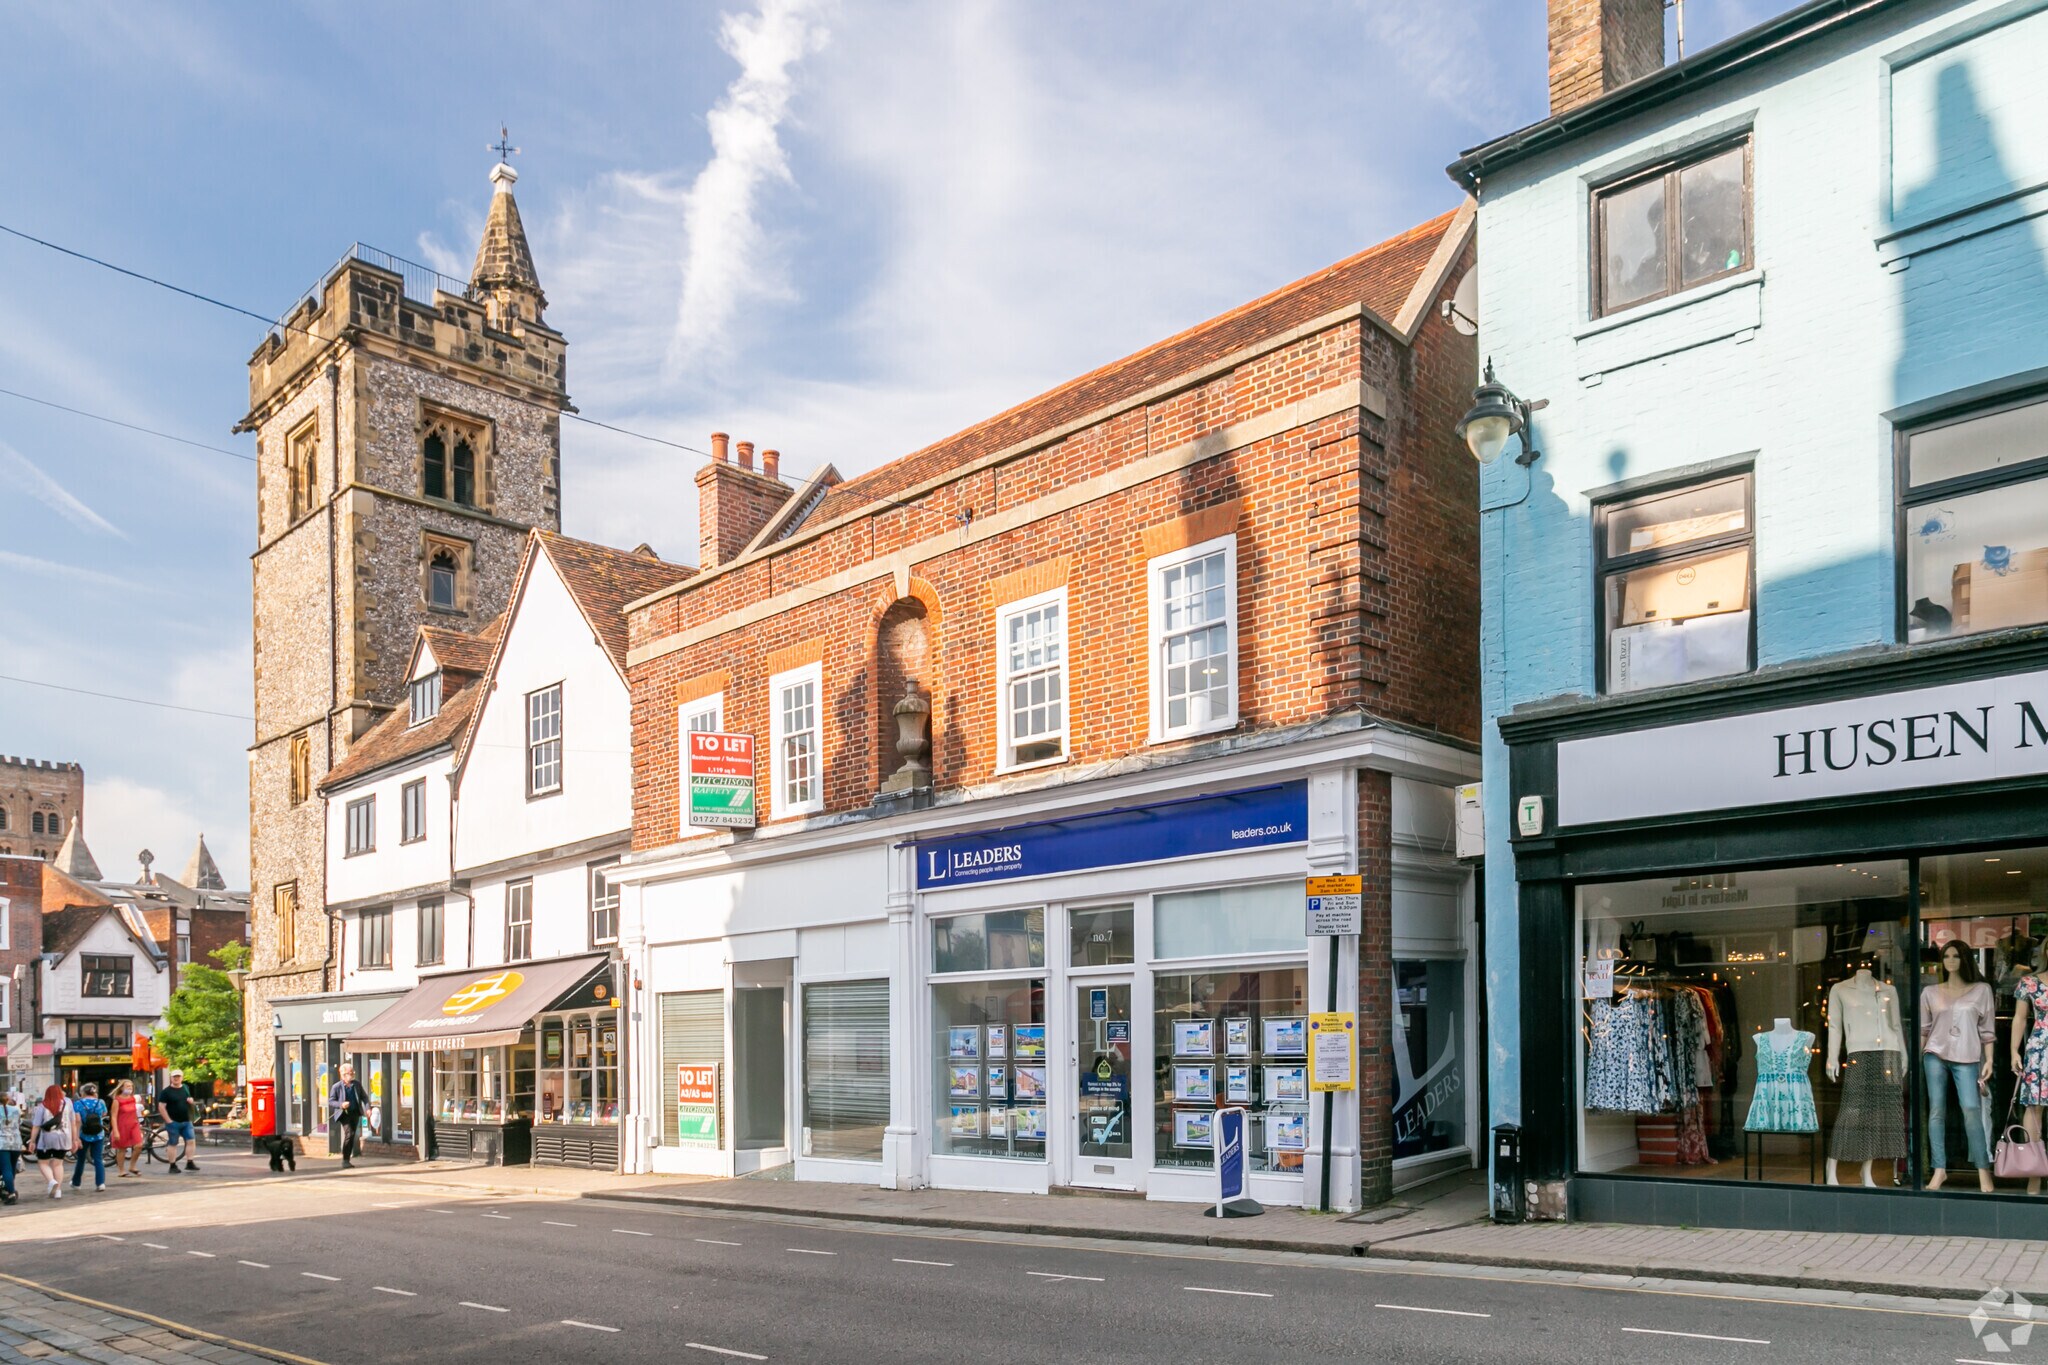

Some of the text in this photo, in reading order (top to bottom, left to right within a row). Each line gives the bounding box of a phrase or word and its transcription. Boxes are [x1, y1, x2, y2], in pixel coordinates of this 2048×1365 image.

[696, 736, 747, 752] TO LET
[1773, 705, 1994, 778] HUSEN
[693, 776, 751, 786] AITCHISON
[723, 817, 753, 825] 843232
[1231, 822, 1291, 839] leaders.co.uk
[928, 845, 1022, 880] L LEADERS
[955, 869, 978, 877] Connecting
[979, 867, 993, 875] people
[1004, 863, 1022, 872] property
[1312, 900, 1319, 909] P
[1093, 930, 1112, 942] no.7
[386, 1038, 465, 1051] THE TRAVEL EXPERTS
[680, 1070, 712, 1085] TO LET
[1395, 1067, 1460, 1144] LEADERS
[1221, 1143, 1239, 1163] EADERS
